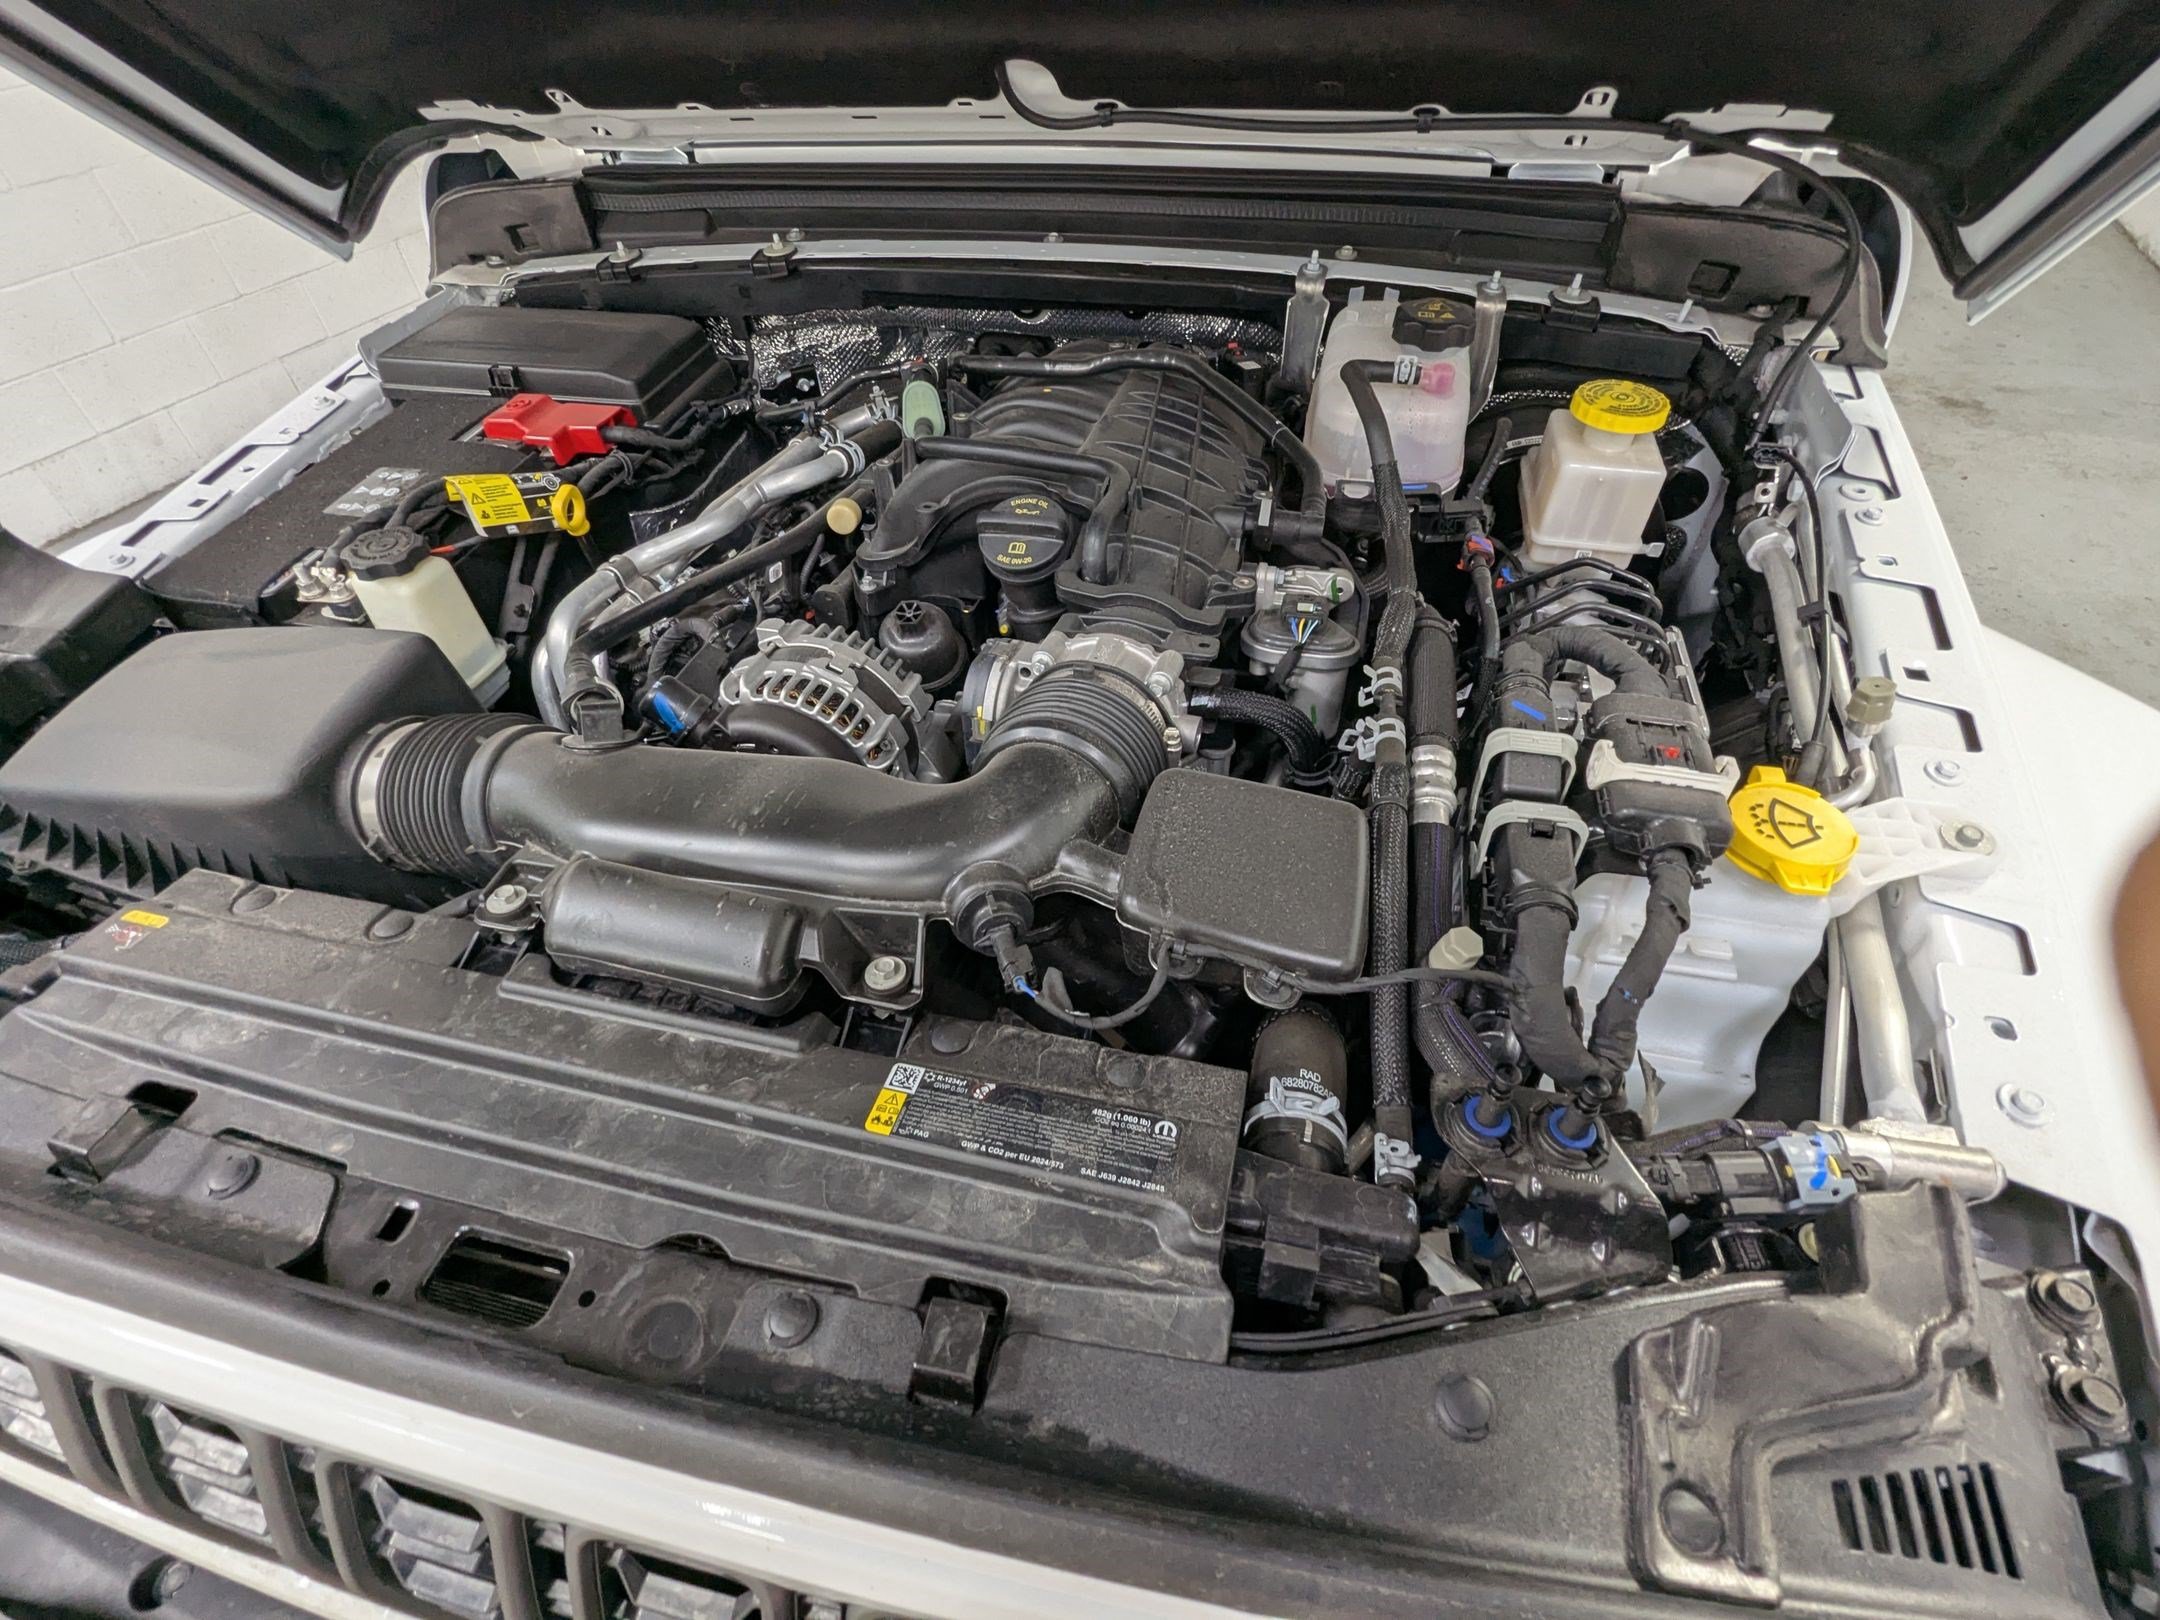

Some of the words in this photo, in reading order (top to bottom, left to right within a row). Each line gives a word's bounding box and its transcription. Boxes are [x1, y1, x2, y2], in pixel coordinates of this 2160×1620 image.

[1011, 498, 1038, 506] ENGINE
[1038, 500, 1048, 509] OIL
[997, 554, 1011, 563] SAE
[1011, 556, 1032, 564] 0W-20
[936, 1075, 967, 1086] R-1234yf
[1300, 1068, 1321, 1082] RAD
[1092, 1108, 1112, 1119] 482g
[914, 1128, 929, 1138] PAG
[961, 1140, 980, 1149] GWP
[988, 1146, 1004, 1155] CO2
[1005, 1150, 1018, 1159] per
[1019, 1153, 1031, 1161] EU
[1081, 1167, 1097, 1177] SAE
[1098, 1172, 1117, 1182] J639
